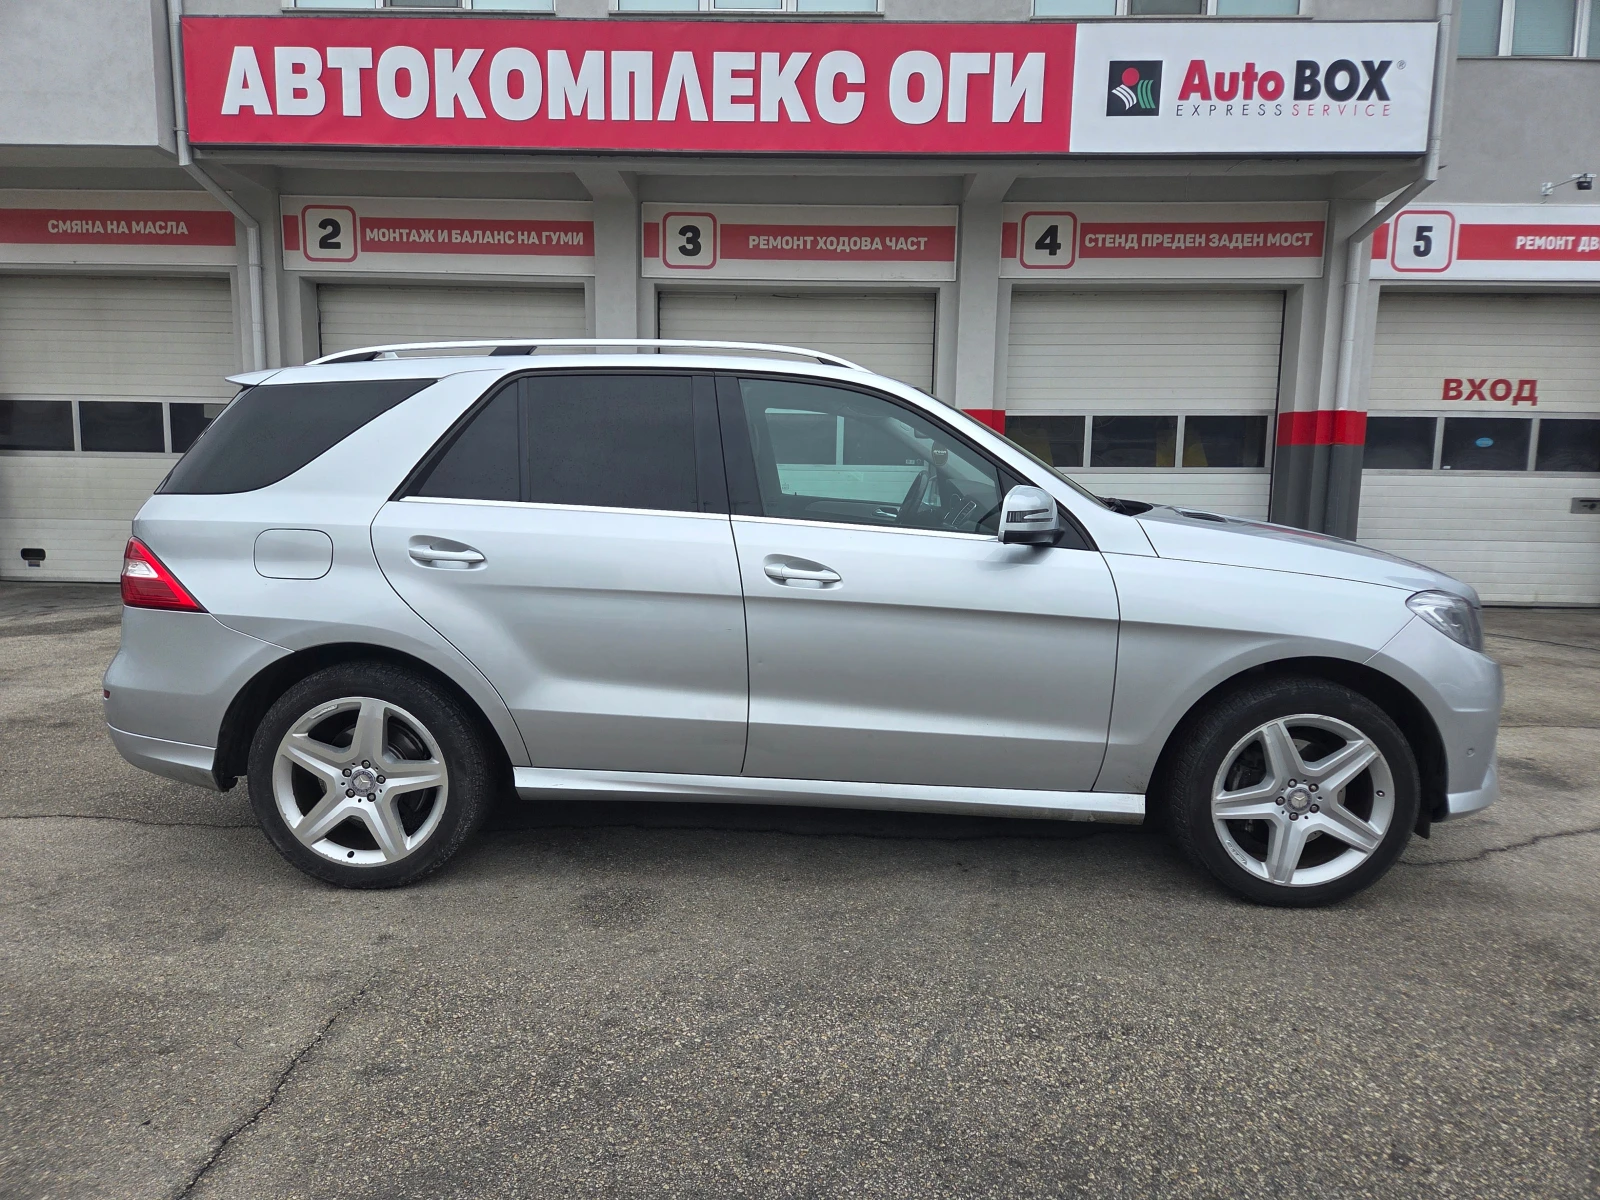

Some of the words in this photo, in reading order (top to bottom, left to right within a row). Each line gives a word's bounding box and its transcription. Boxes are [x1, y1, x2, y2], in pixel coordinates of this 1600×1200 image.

[221, 46, 866, 125] АВТОКОМПЛЕКС
[889, 50, 1046, 125] ОГИ
[1177, 59, 1285, 102] Auto
[47, 219, 104, 234] СМЯНА
[107, 220, 130, 235] НА
[131, 221, 189, 235] МАСЛА
[318, 217, 342, 249] 2
[365, 228, 435, 243] МОНТАЖ
[437, 229, 449, 243] И
[451, 229, 515, 244] БАЛАНС
[518, 231, 540, 245] НА
[541, 231, 584, 245] ГУМИ
[678, 224, 702, 257] 3
[1034, 224, 1062, 256] 4
[1084, 233, 1139, 249] СТЕНД
[1141, 233, 1207, 249] ПРЕДЕН
[1208, 233, 1264, 249] ЗАДЕН
[1267, 232, 1314, 247] МОСТ
[1412, 225, 1434, 257] 5
[748, 235, 814, 250] РЕМОНТ
[815, 236, 883, 252] ХОДОВА
[885, 237, 928, 251] ЧАСТ
[1515, 235, 1576, 250] РЕМОНТ
[1576, 236, 1600, 252] ДВ
[1441, 378, 1539, 407] ВХОД
